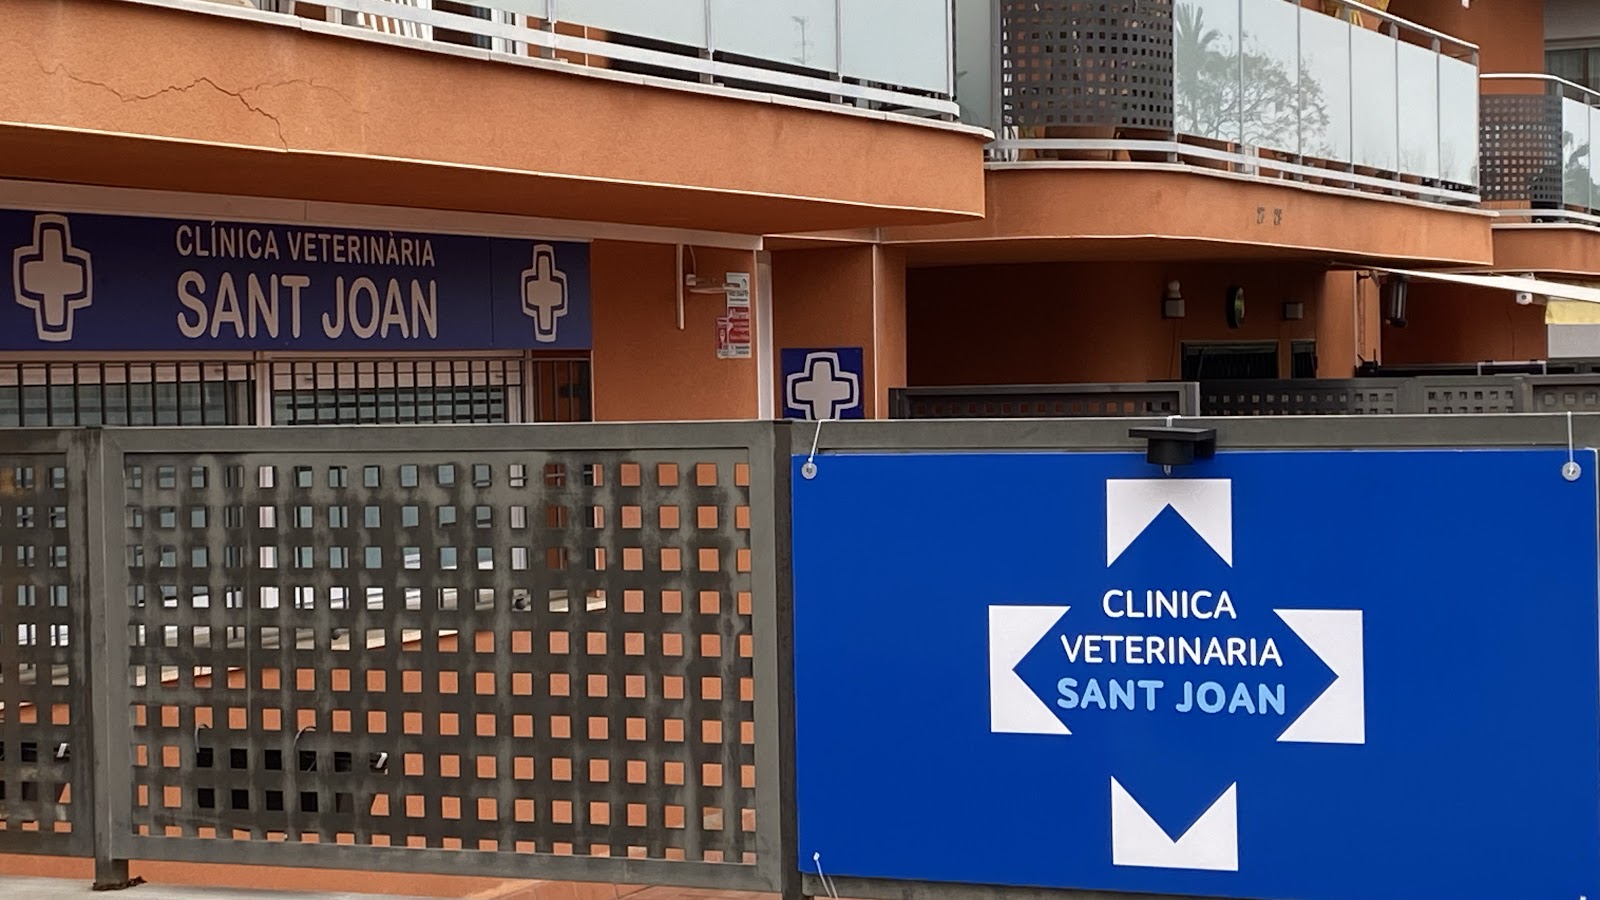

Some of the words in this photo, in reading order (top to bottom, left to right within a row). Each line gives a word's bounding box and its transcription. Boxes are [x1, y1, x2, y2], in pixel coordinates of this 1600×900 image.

[176, 221, 279, 260] CLÍNICA
[288, 231, 436, 267] VETERINÀRIA
[177, 271, 310, 338] SANT
[322, 276, 437, 339] JOAN
[1102, 589, 1237, 619] CLINICA
[1060, 634, 1283, 667] VETERINARIA
[1056, 677, 1164, 711] SANT
[1175, 680, 1285, 716] JOAN
